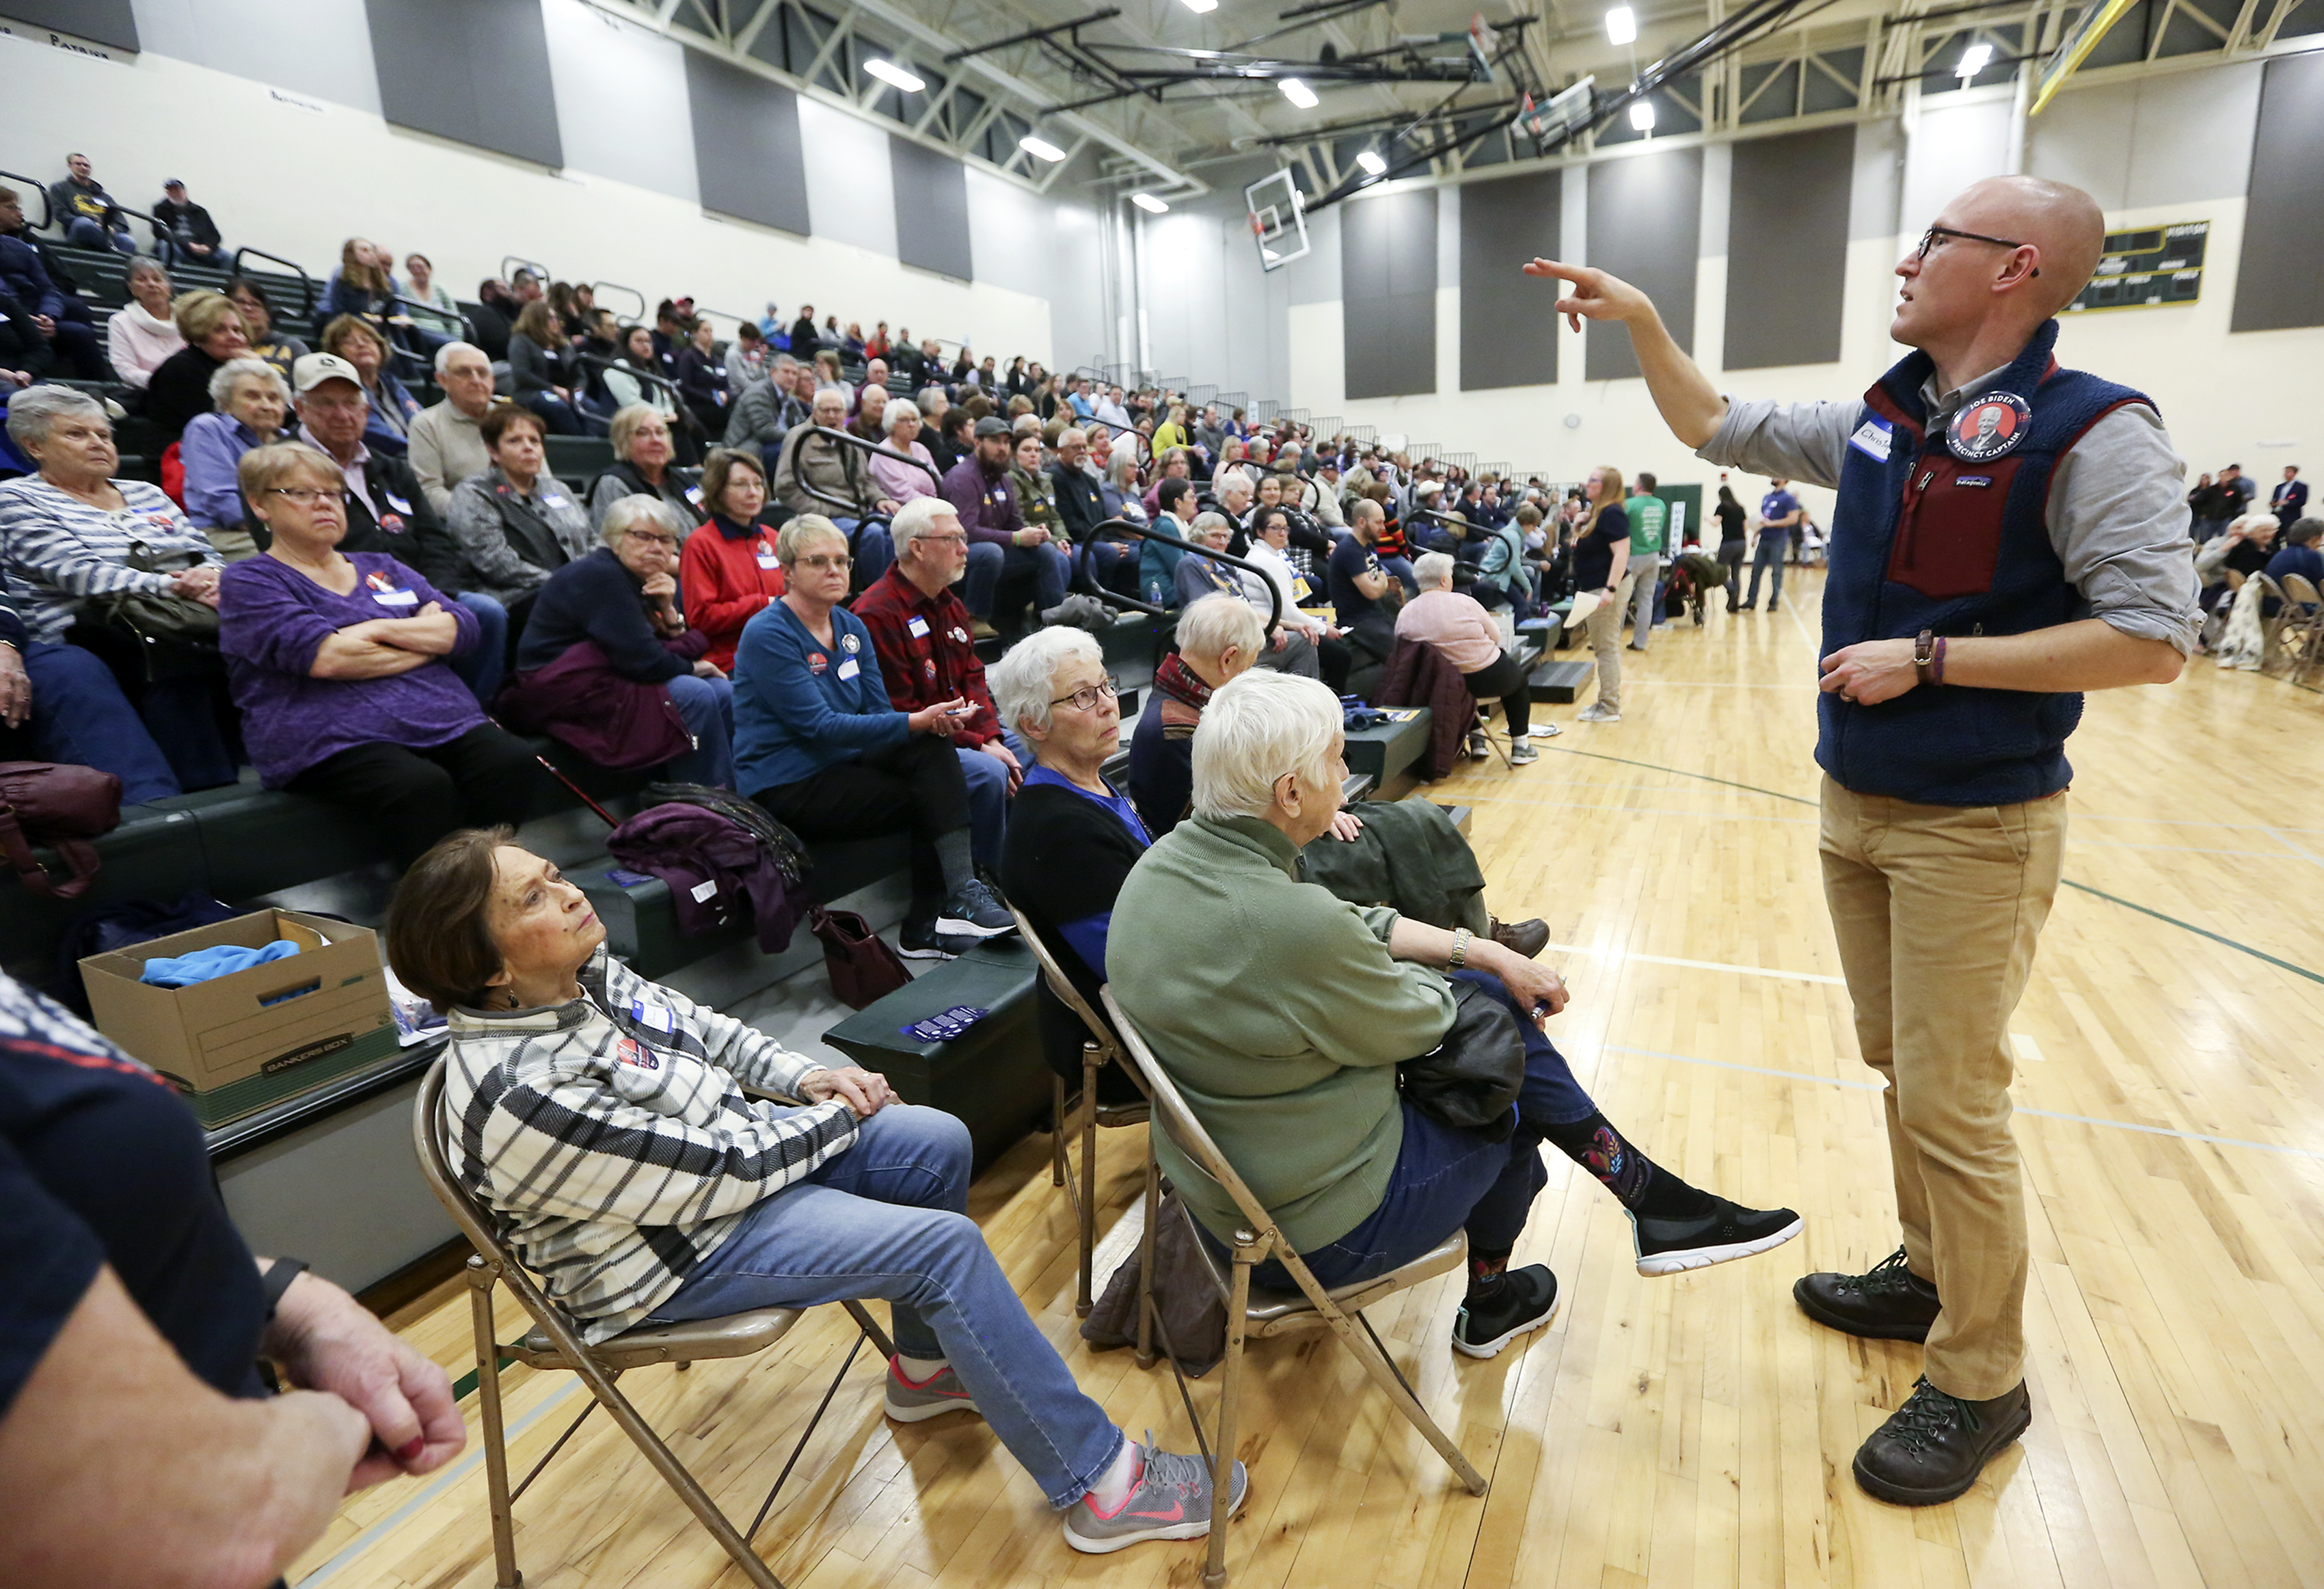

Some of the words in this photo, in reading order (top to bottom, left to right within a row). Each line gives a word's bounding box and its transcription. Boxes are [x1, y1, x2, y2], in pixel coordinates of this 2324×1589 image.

[1970, 397, 1987, 410] JOE
[1988, 395, 2015, 405] BIDEN
[1952, 438, 1984, 458] PRECINCT
[1986, 431, 2021, 457] CAPTAIN
[267, 1047, 323, 1072] BANKERS
[323, 1038, 348, 1052] BOX
